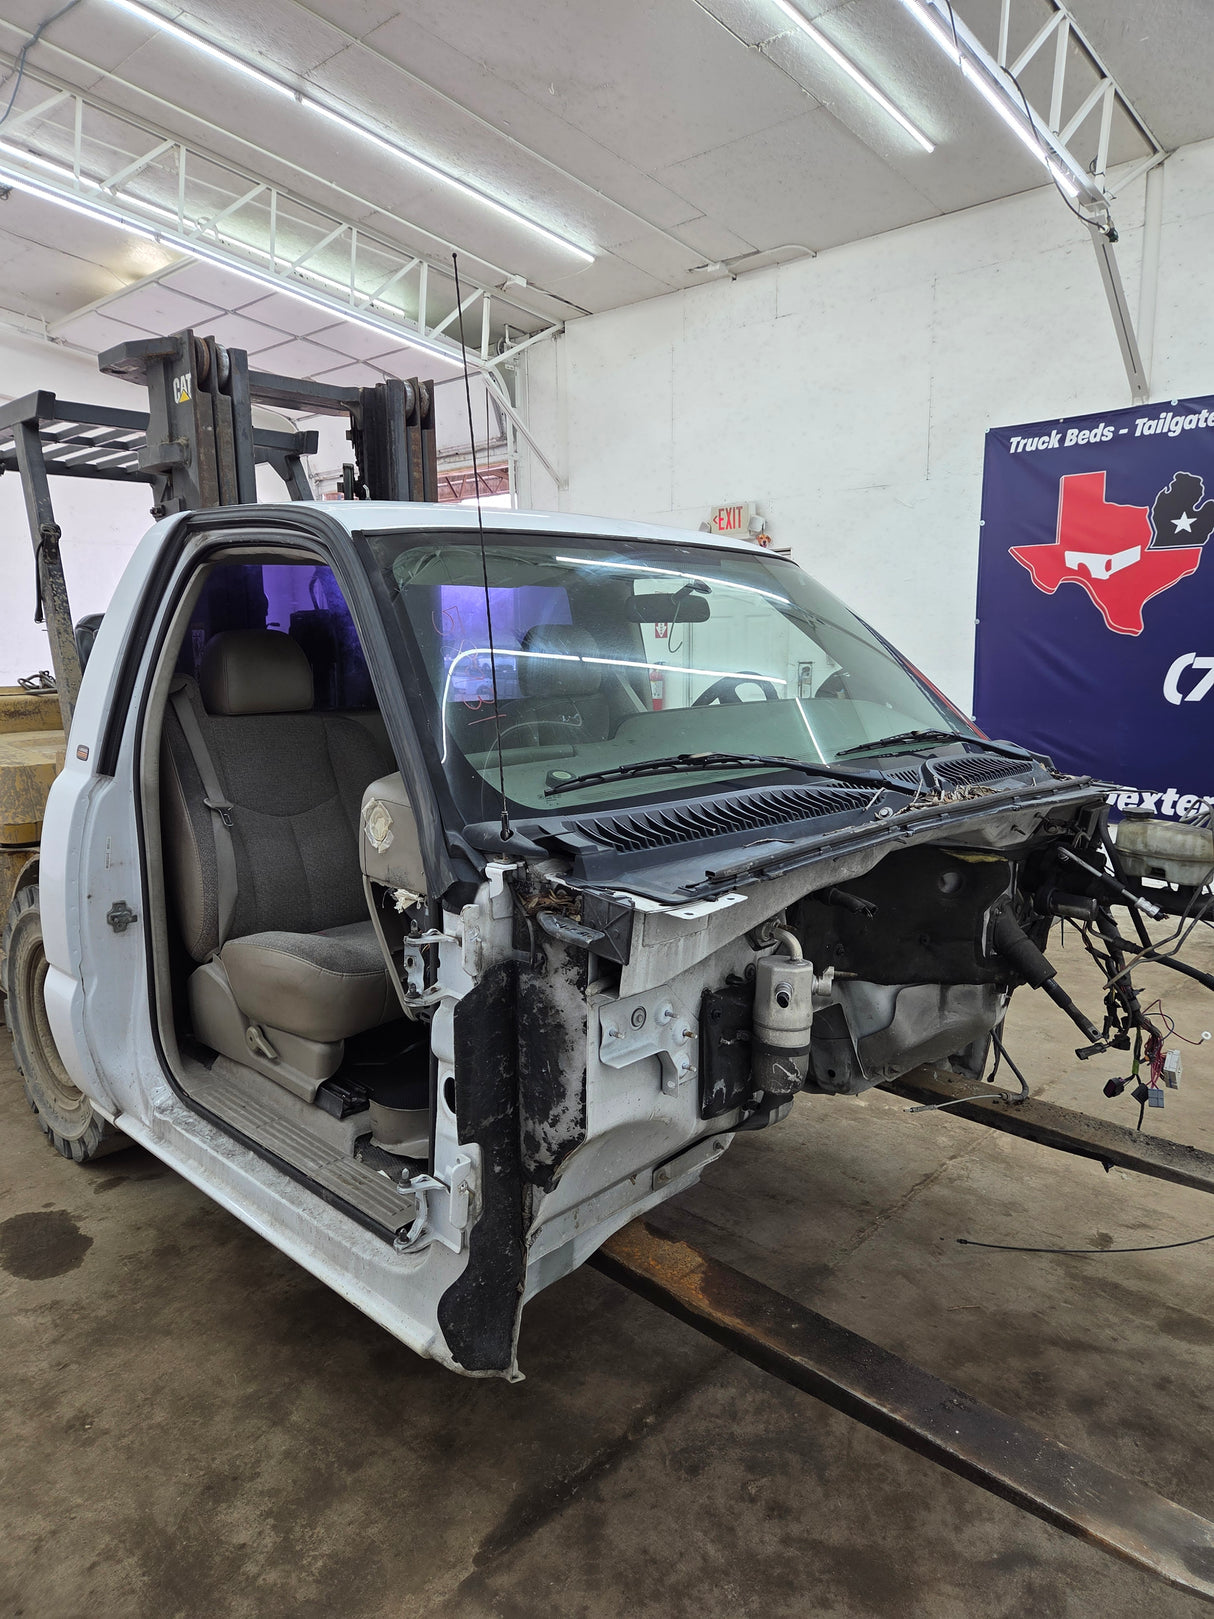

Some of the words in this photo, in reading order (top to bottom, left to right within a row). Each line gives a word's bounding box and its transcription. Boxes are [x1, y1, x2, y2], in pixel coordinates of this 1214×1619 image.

[173, 373, 192, 404] CAT
[1009, 430, 1063, 453] Truck
[1064, 423, 1114, 447] Beds
[718, 506, 743, 531] EXIT
[1105, 786, 1214, 817] exter
